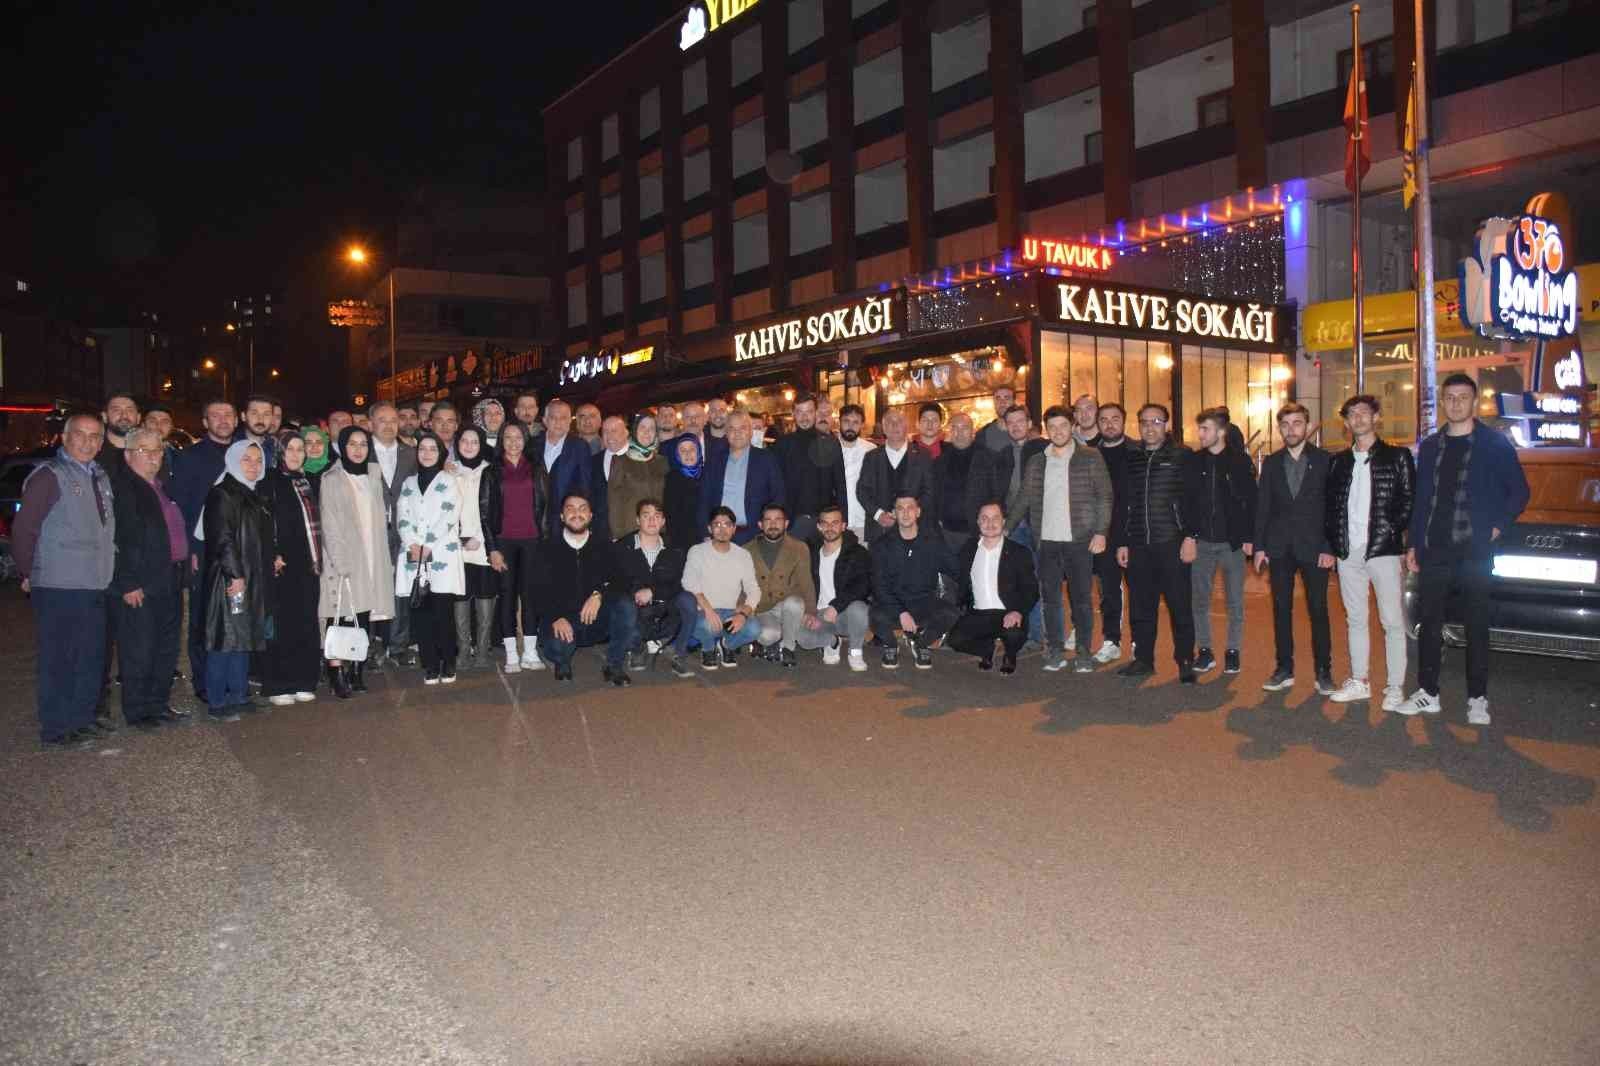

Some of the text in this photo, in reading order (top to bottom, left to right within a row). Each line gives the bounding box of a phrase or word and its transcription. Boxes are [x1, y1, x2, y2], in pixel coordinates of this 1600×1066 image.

[1041, 241, 1099, 269] TAVUK
[1059, 284, 1170, 330] KAHVE
[1175, 300, 1273, 343] SOKAĞI
[1499, 257, 1577, 335] Bowling
[734, 297, 892, 362] KAHVE SOKAĞI
